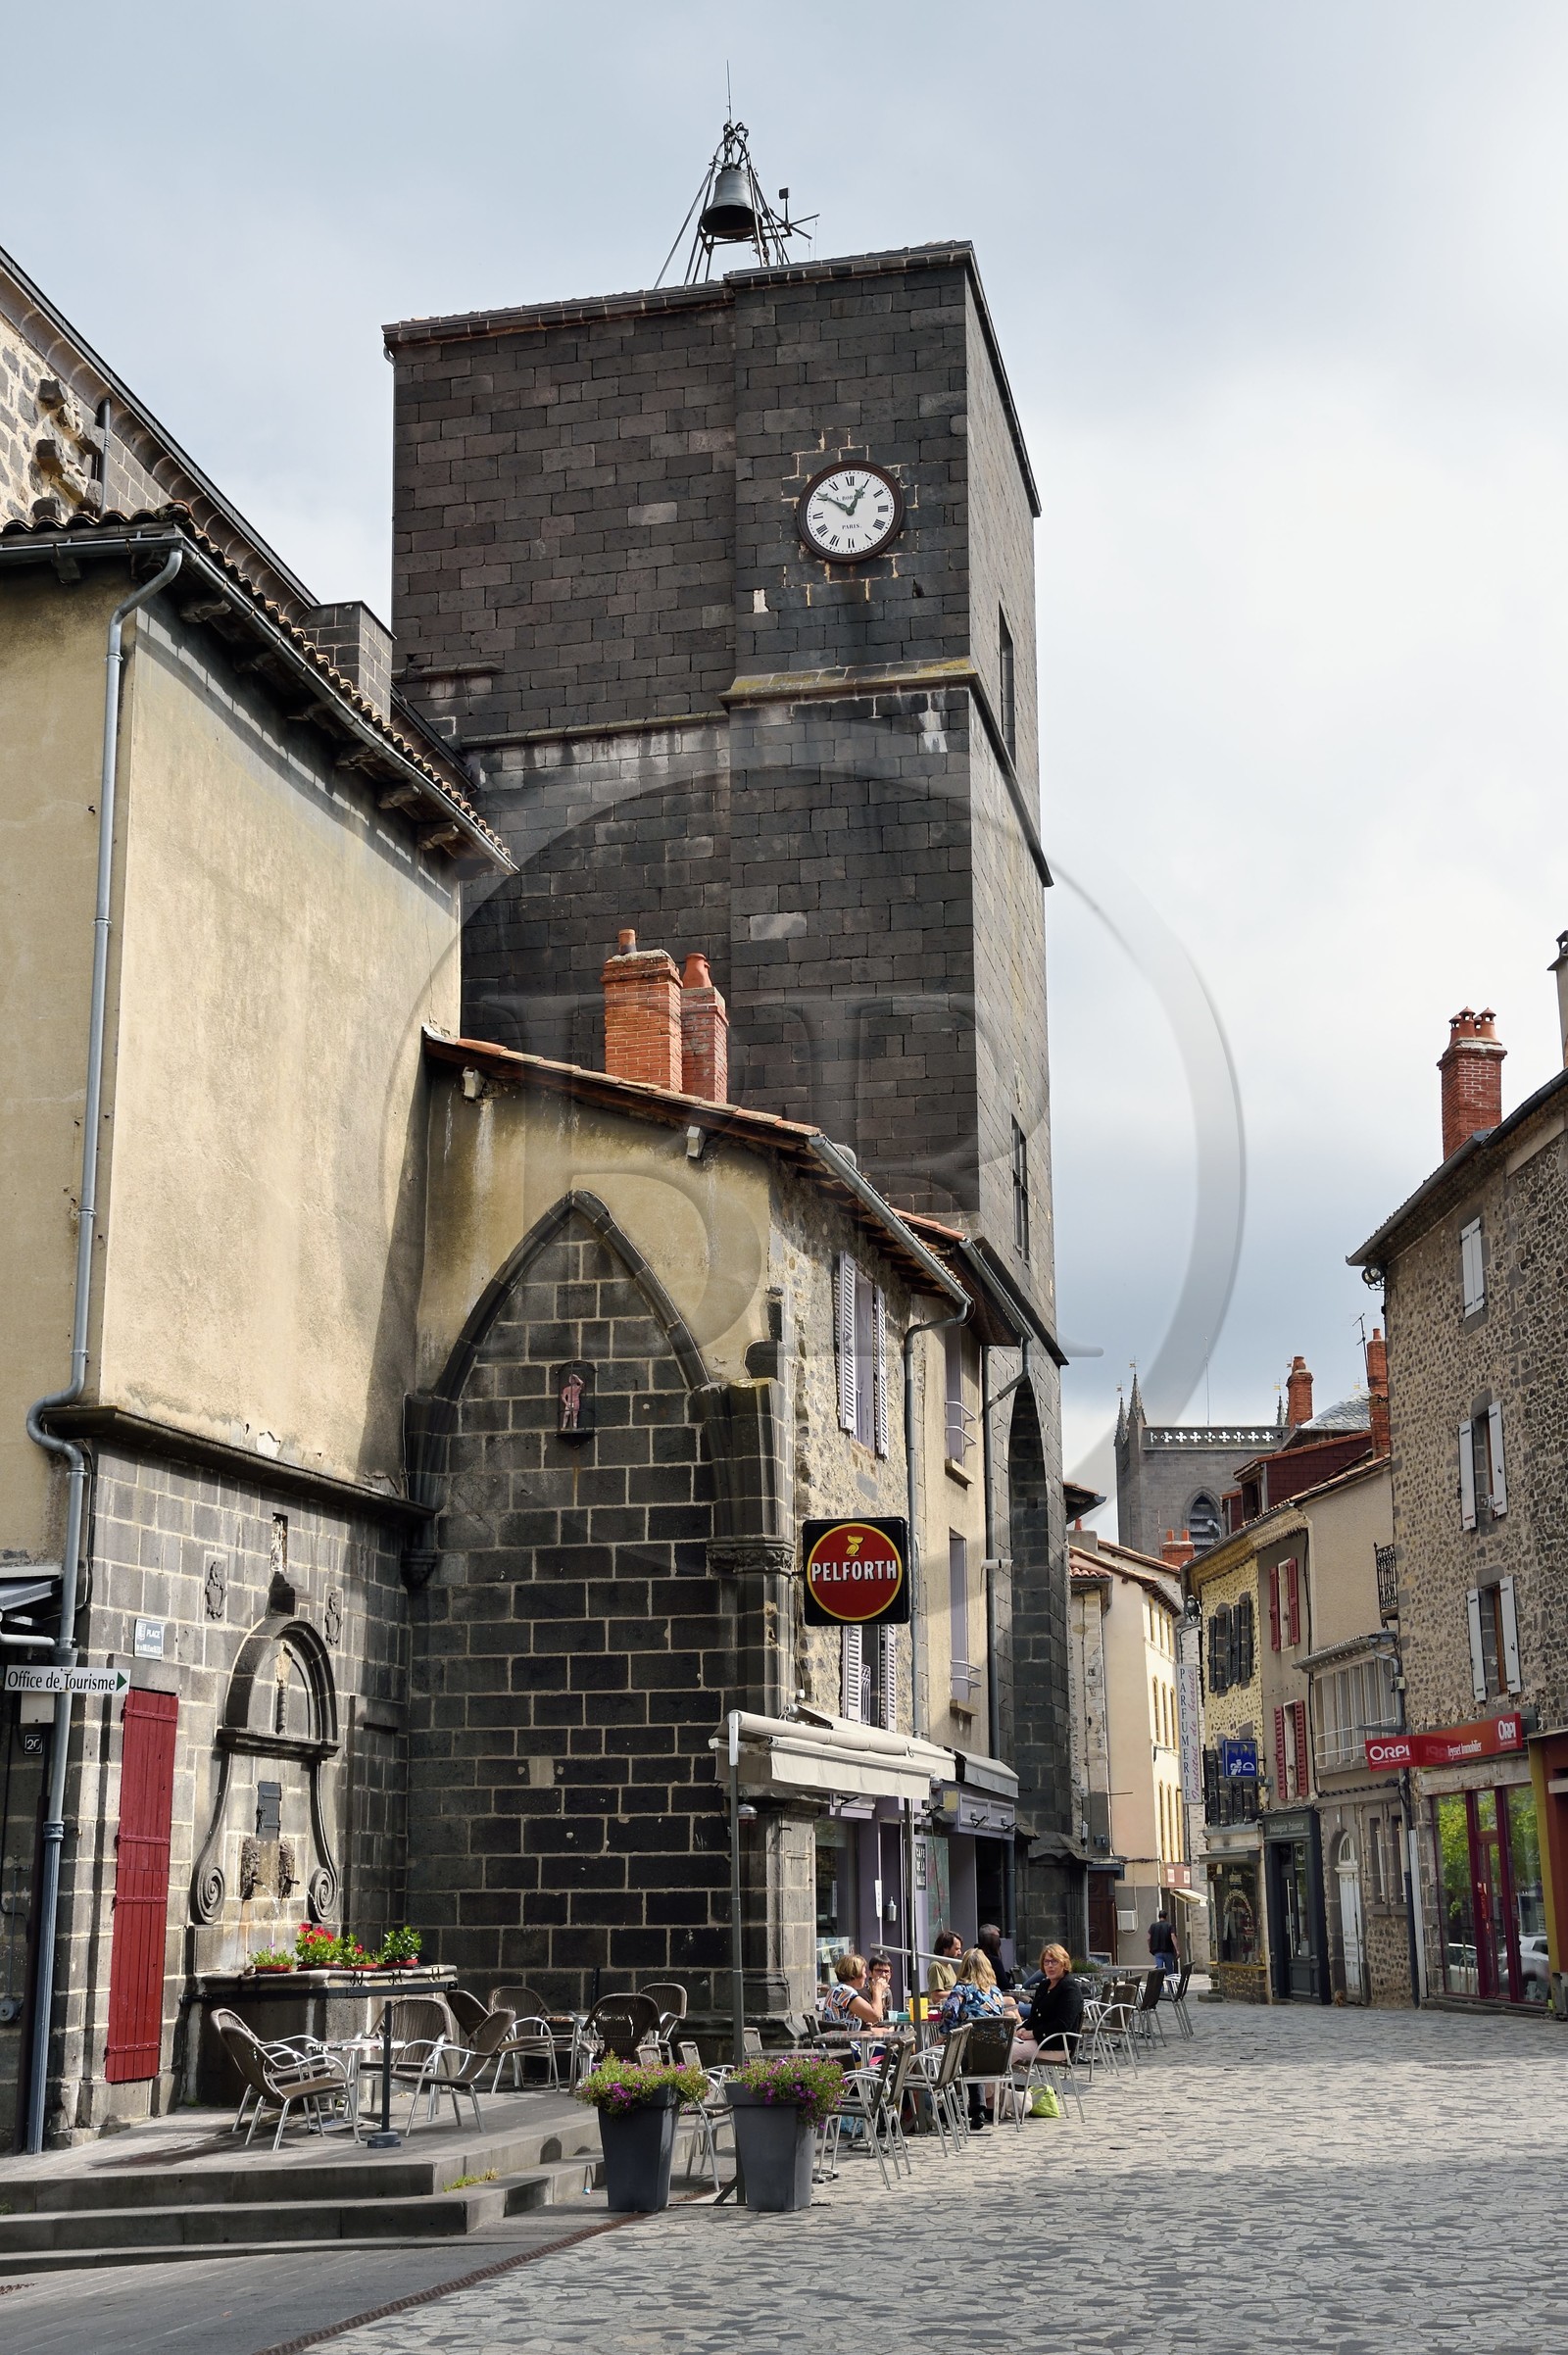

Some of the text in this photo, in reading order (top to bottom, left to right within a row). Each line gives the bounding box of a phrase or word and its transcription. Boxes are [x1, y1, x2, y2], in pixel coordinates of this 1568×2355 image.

[811, 1559, 898, 1582] PELFORTH
[146, 1629, 161, 1639] PLACE
[8, 1670, 116, 1691] Office de Tourisme
[1179, 1667, 1192, 1801] PARFUMERIE
[1189, 1720, 1198, 1737] de
[1498, 1720, 1516, 1742] ORPI
[1369, 1743, 1411, 1761] ORPI
[1191, 1745, 1200, 1800] Institut
